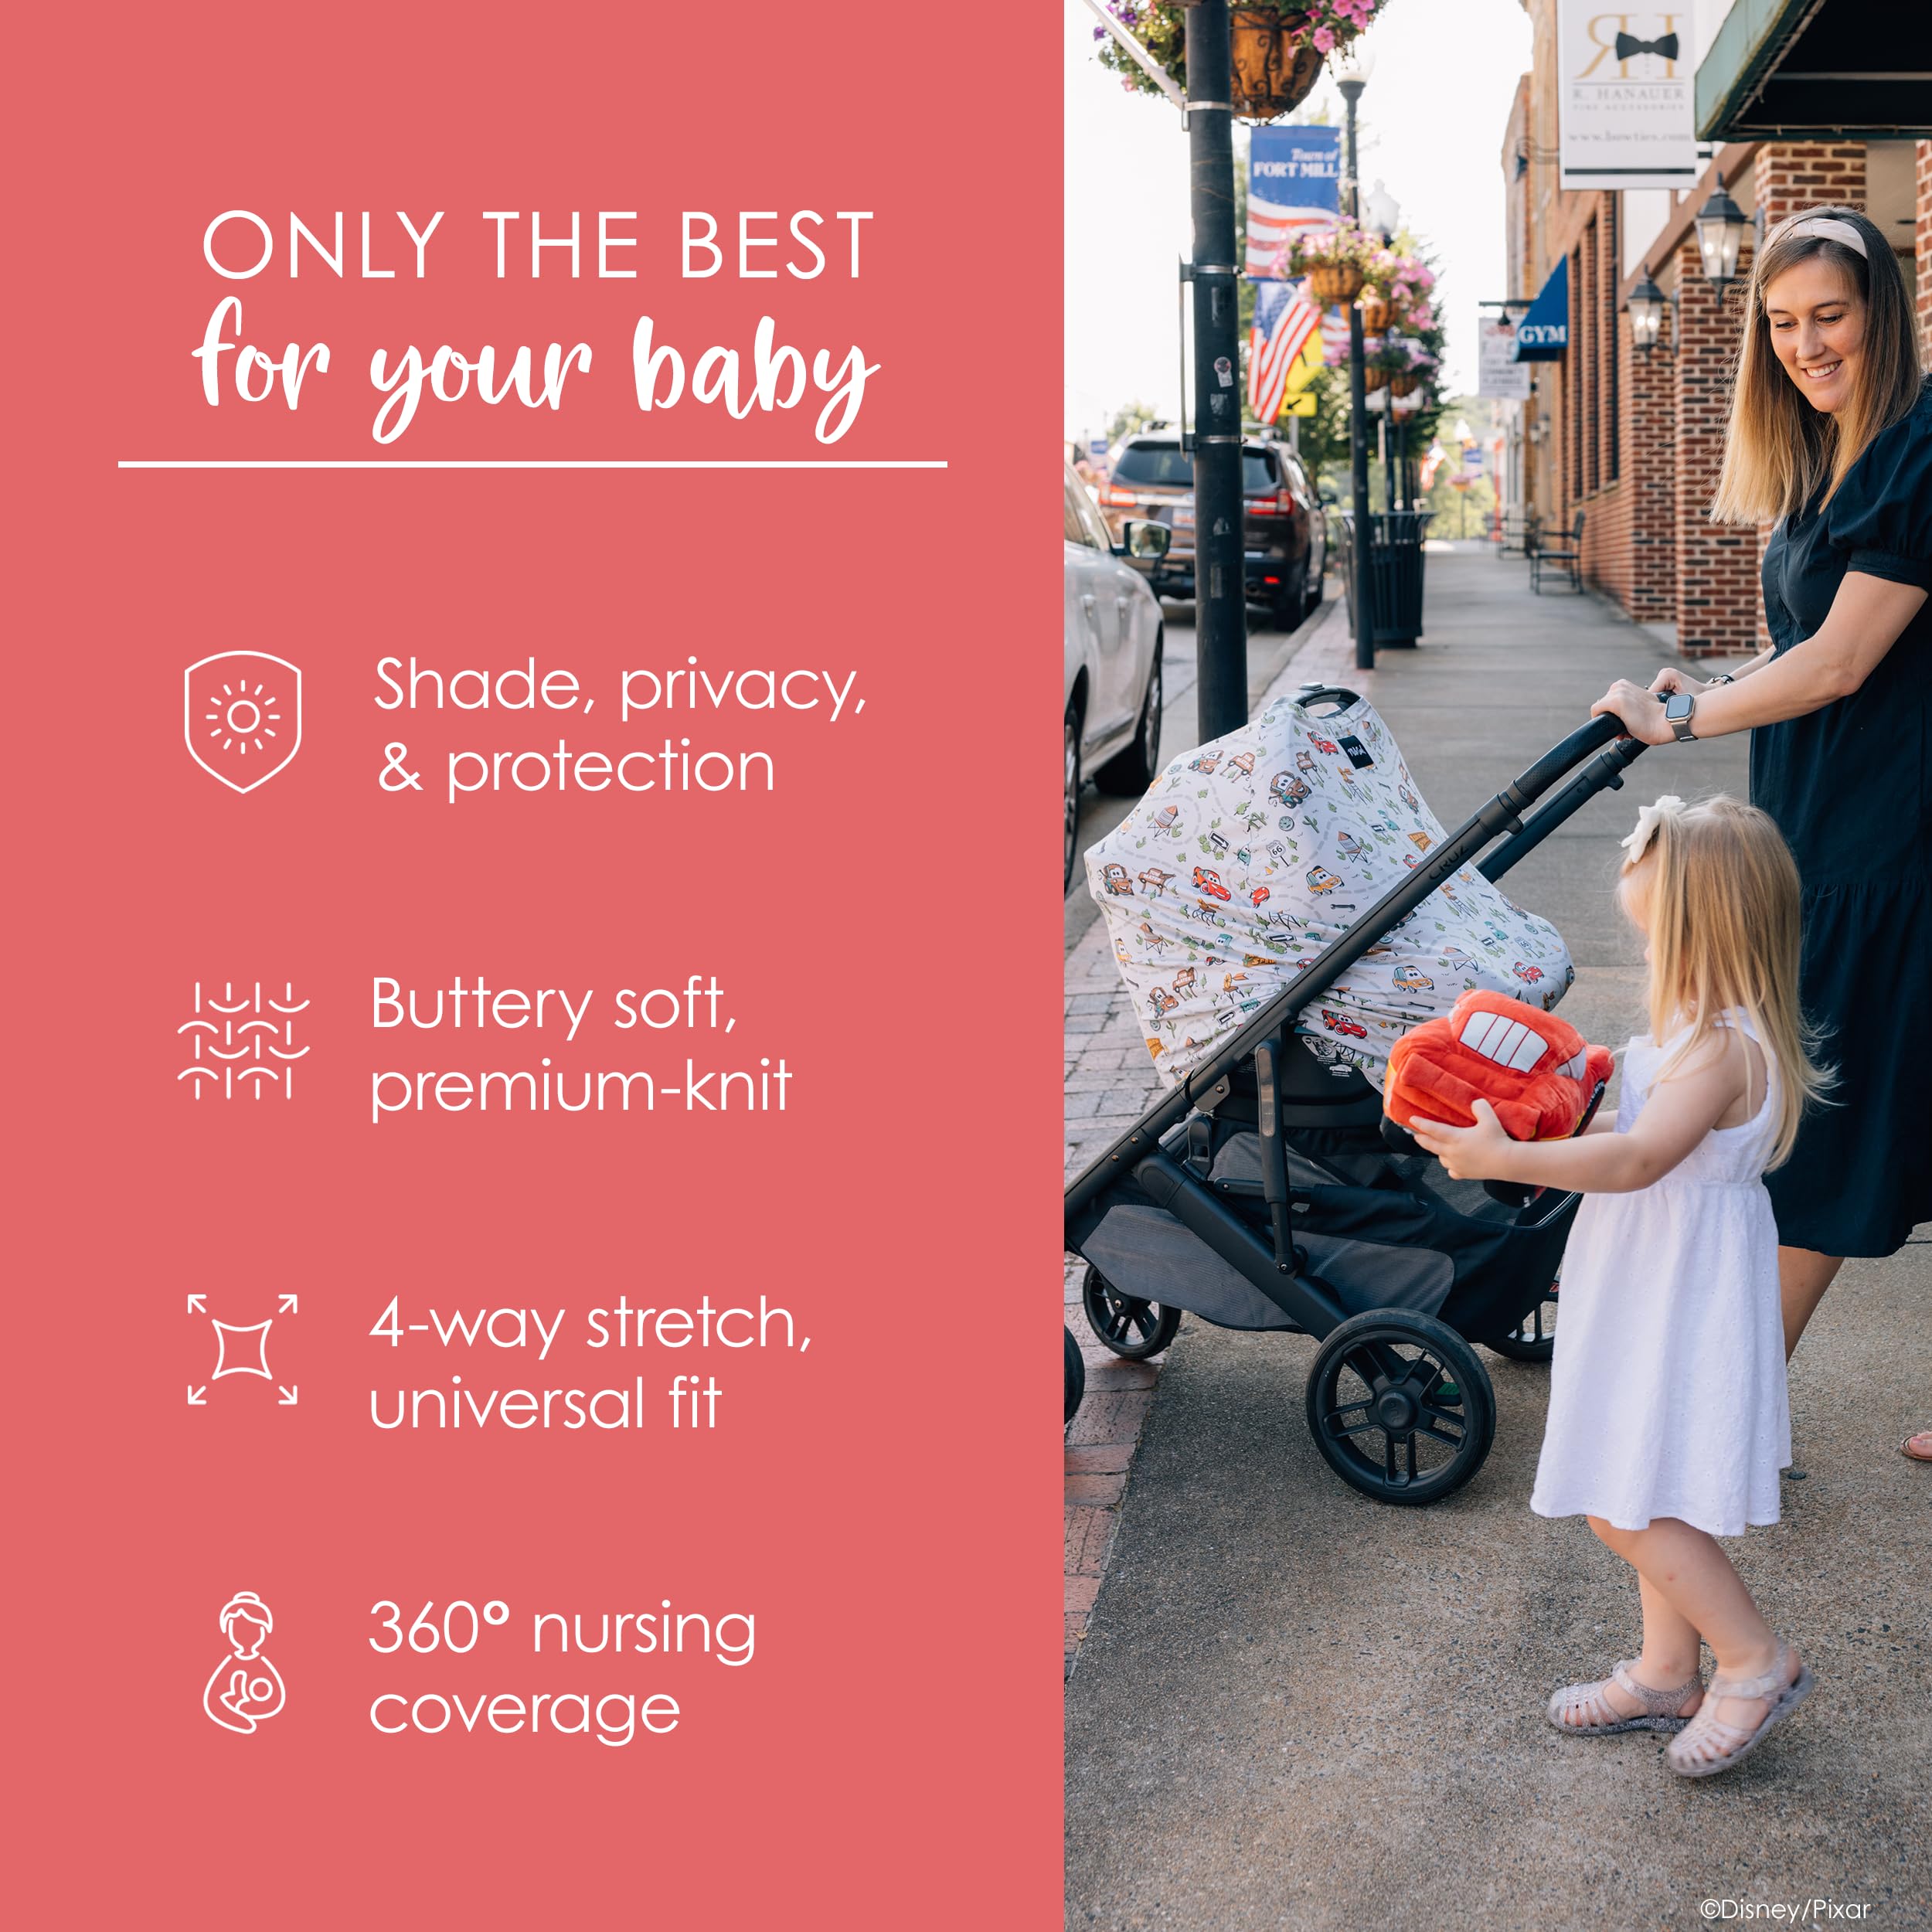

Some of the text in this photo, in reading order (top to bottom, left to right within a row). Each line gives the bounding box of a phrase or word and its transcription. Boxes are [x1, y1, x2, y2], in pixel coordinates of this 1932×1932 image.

[1597, 88, 1684, 100] HANAUER
[1253, 162, 1338, 178] FORT MILL
[1519, 325, 1567, 344] GYM
[1272, 845, 1283, 855] 66
[1430, 845, 1469, 879] CRUZ
